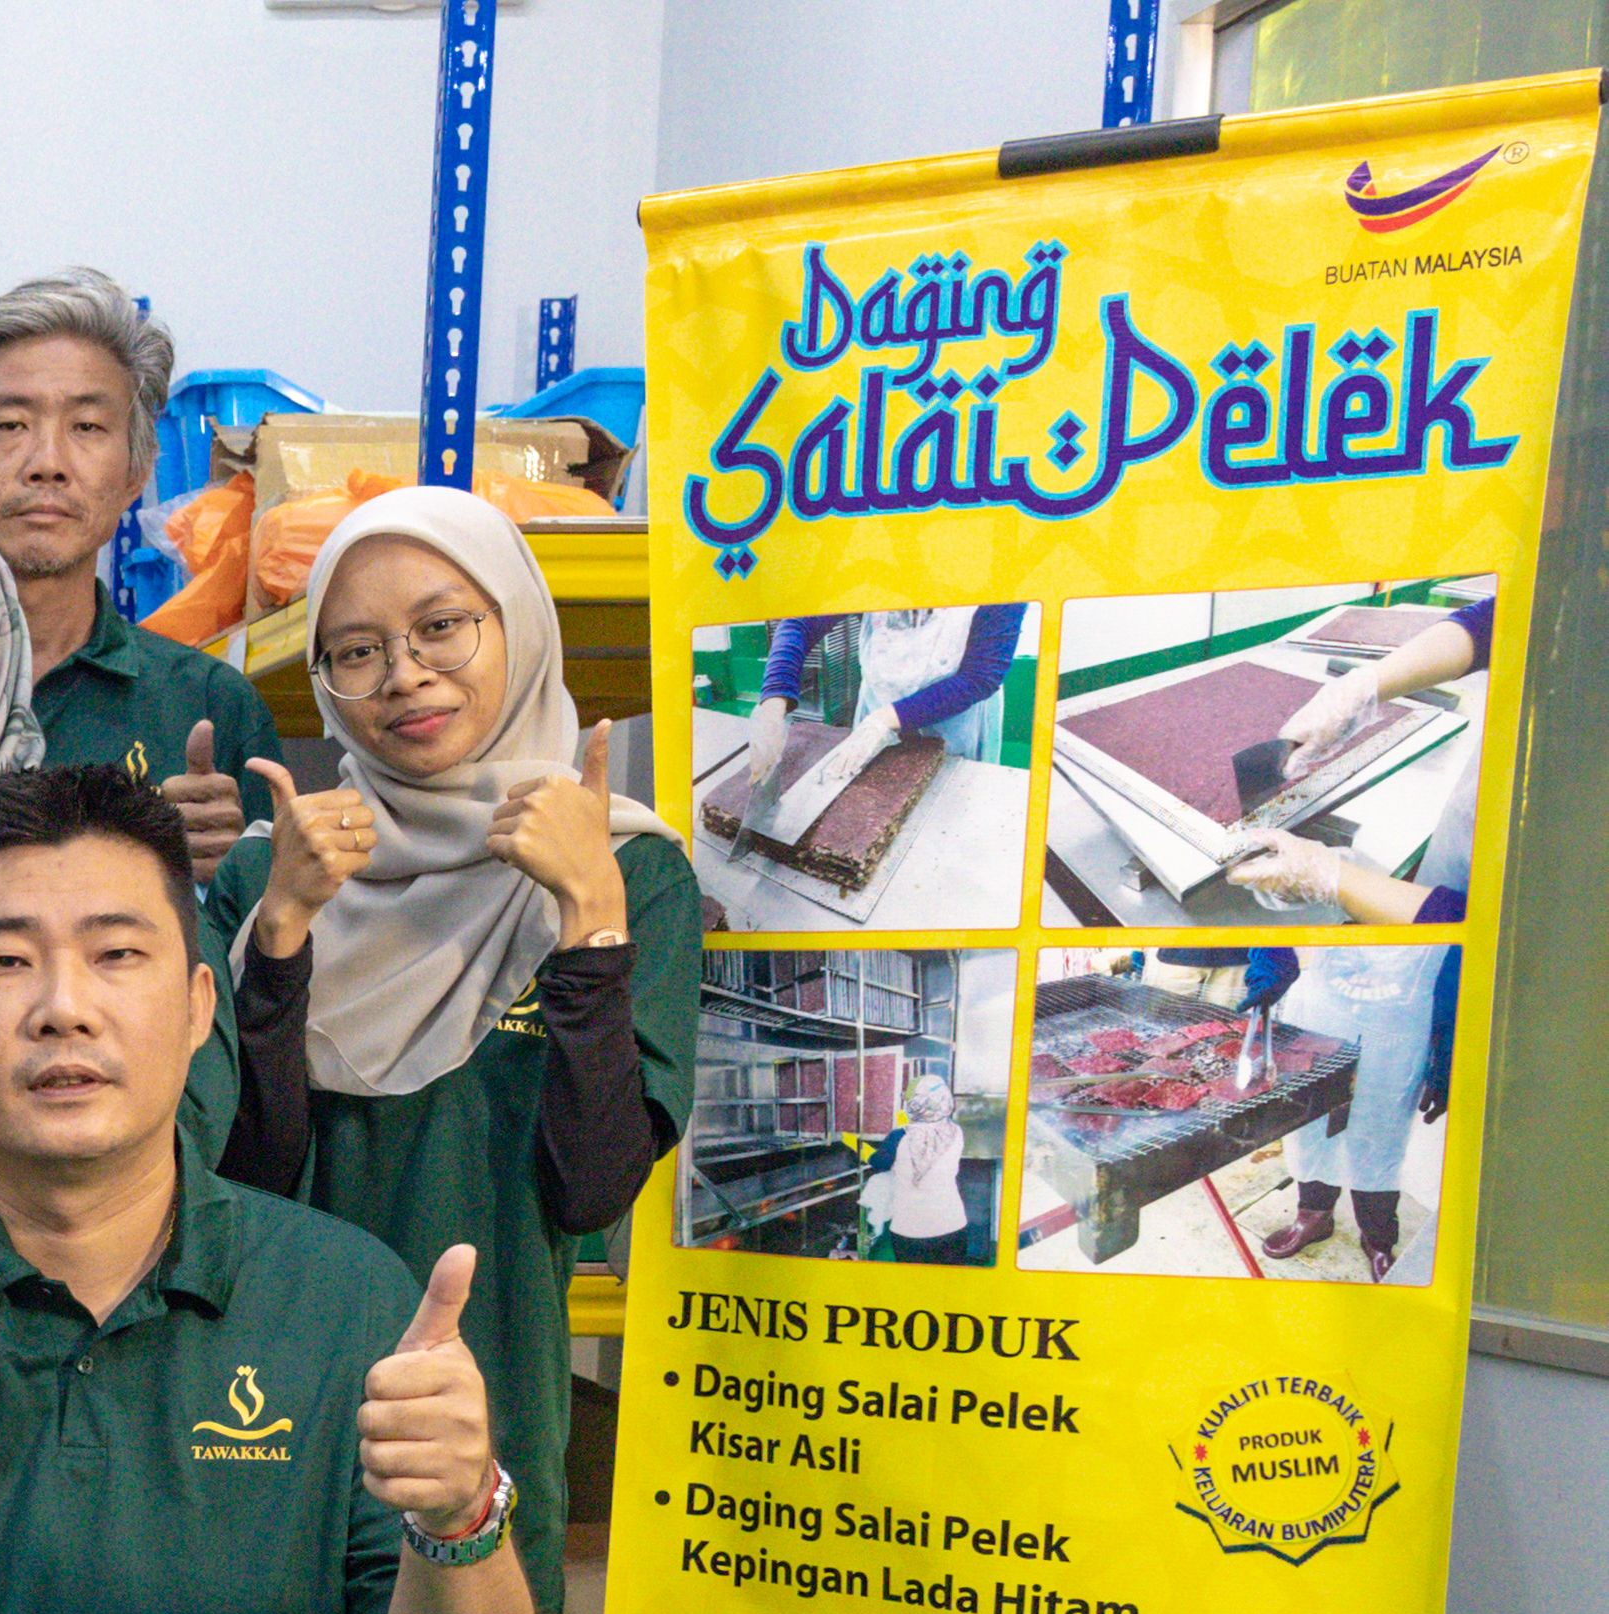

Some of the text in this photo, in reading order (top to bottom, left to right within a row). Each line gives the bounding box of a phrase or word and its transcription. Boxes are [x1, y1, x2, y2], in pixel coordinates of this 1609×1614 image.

[1325, 246, 1522, 285] BUATAN MALAYSIA
[668, 1291, 1079, 1360] JENIS PRODUK
[694, 1364, 1078, 1433] Daging Salai Pelek
[1197, 1377, 1365, 1439] KUALITI TERBAIK
[191, 1445, 291, 1460] TAWAKKAL
[691, 1421, 860, 1474] Kisar Asli
[1232, 1455, 1340, 1483] MUSLIM
[1239, 1429, 1323, 1451] PRODUK
[687, 1483, 1069, 1562] Daging Salai Pelek
[1193, 1449, 1375, 1540] KELUARAN BUMIPUTERA
[682, 1539, 868, 1598] Kepingan
[883, 1567, 978, 1613] Lada
